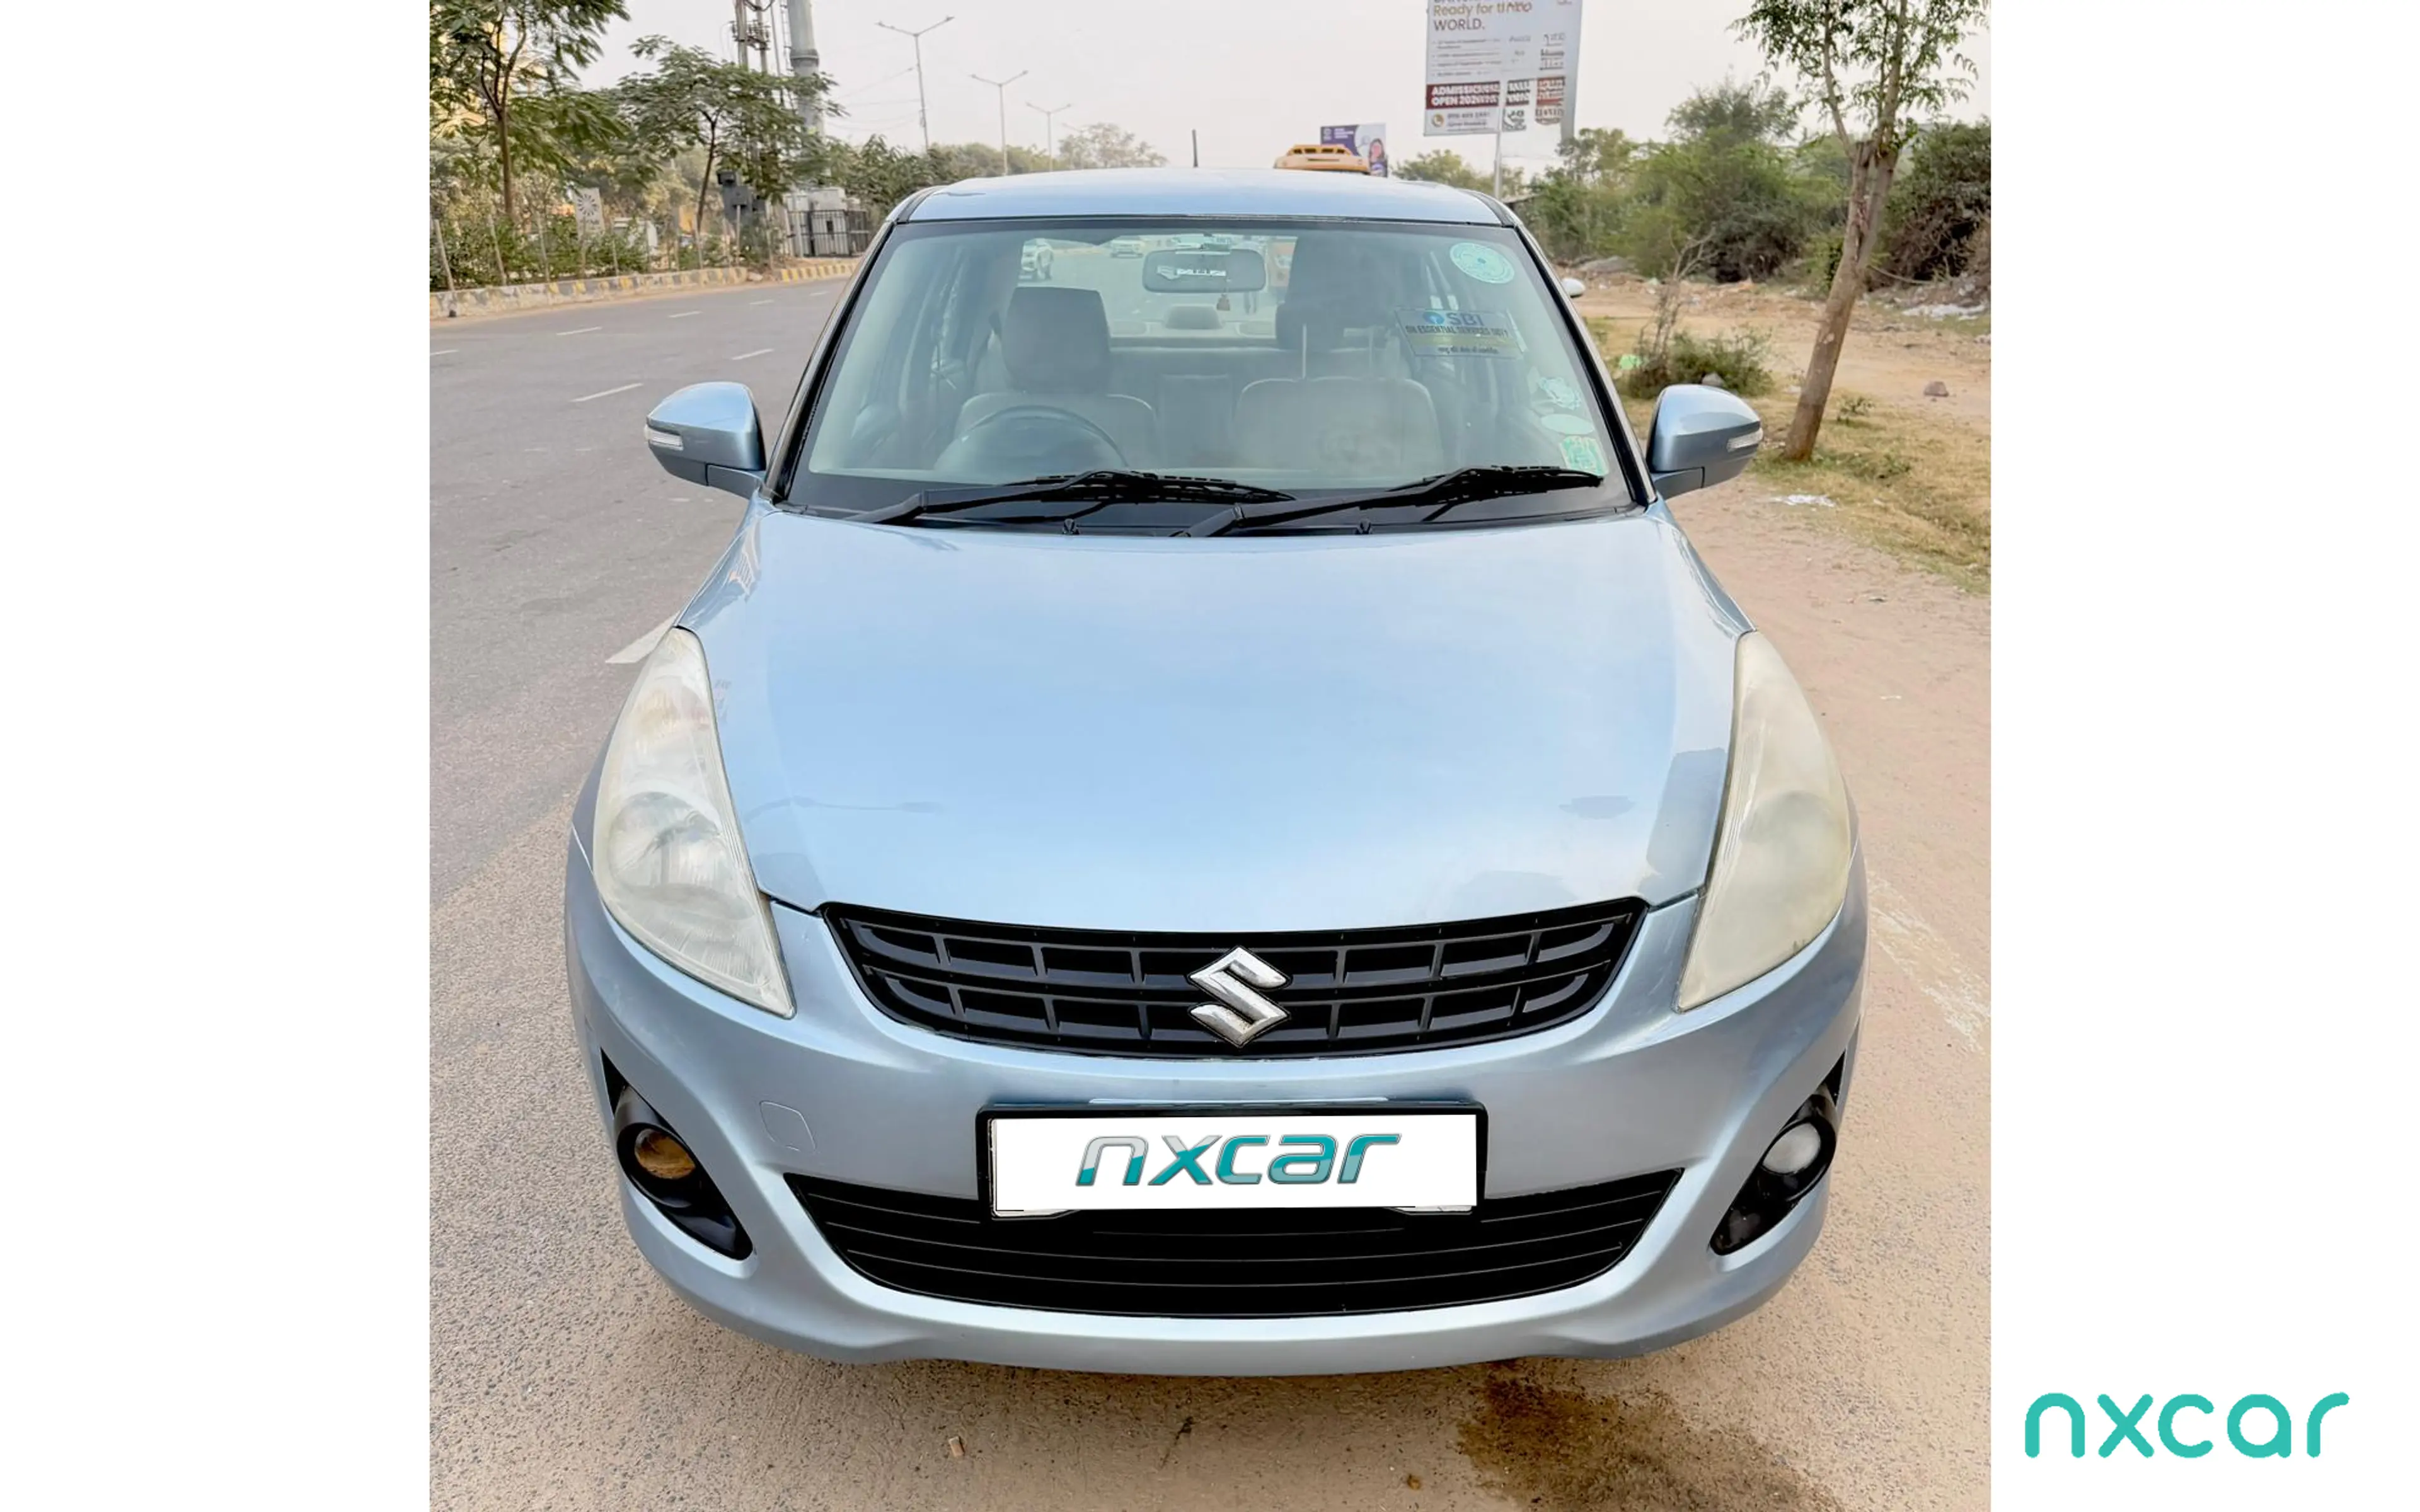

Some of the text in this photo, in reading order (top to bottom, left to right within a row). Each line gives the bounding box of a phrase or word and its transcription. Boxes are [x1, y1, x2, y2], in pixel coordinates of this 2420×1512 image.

[1434, 4, 1473, 17] Ready
[1477, 4, 1493, 15] for
[1434, 18, 1485, 31] WORLD.
[1446, 312, 1485, 326] SBI
